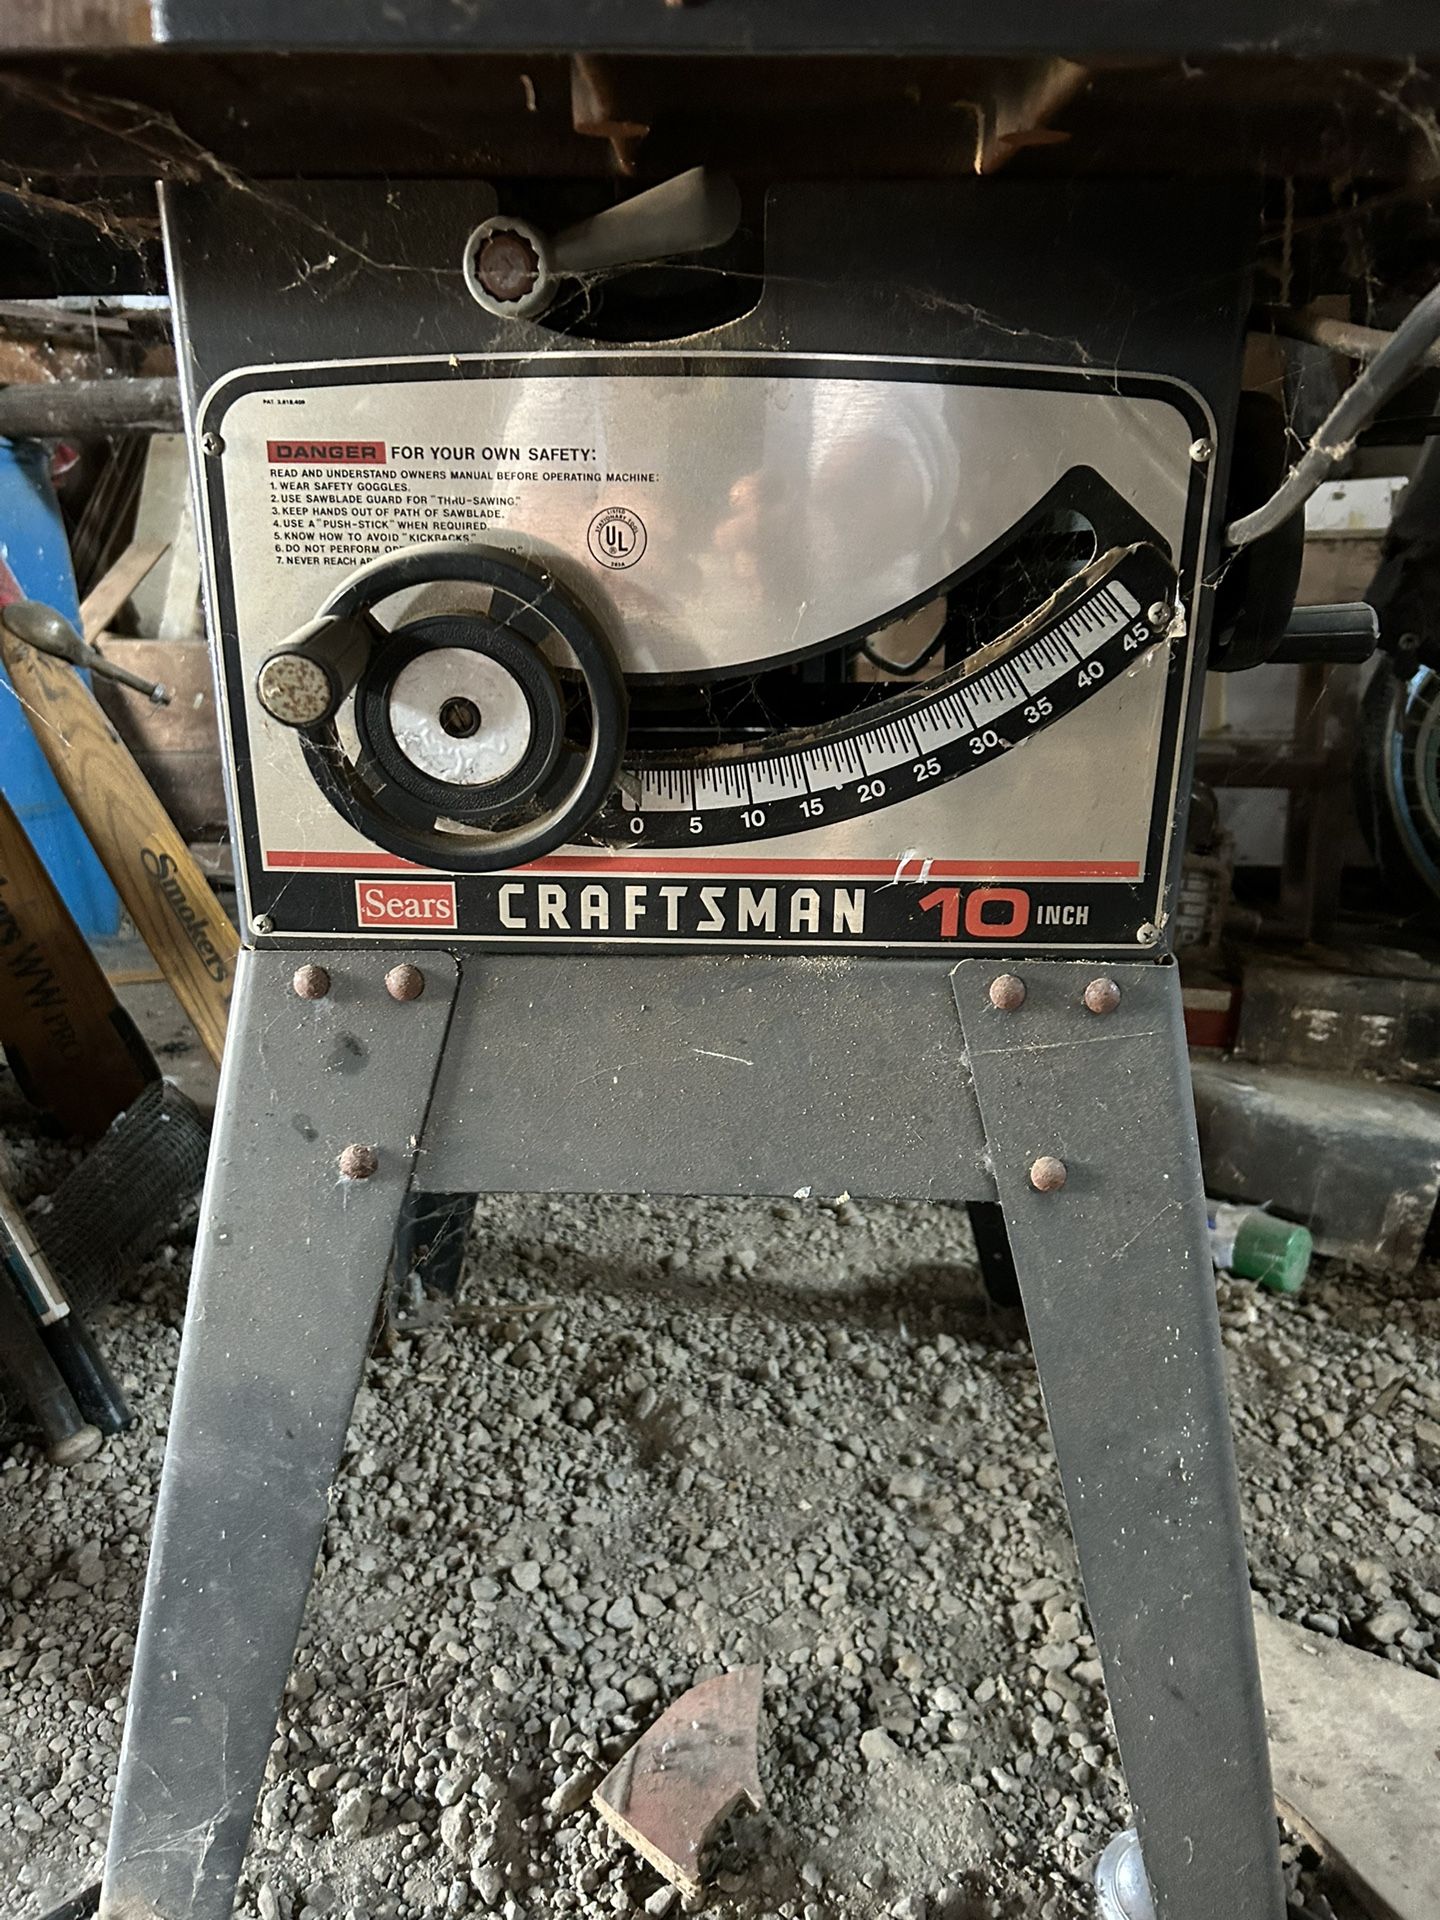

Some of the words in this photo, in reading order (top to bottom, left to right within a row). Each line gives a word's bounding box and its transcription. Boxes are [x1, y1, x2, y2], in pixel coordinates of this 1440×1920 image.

[276, 445, 377, 460] DANGER
[391, 446, 425, 460] FOR
[430, 446, 476, 461] YOUR
[481, 447, 521, 461] OWN
[528, 447, 597, 462] SAFETY:
[270, 468, 298, 478] READ
[301, 469, 324, 478] AND
[326, 469, 398, 479] UNDERSTAND
[400, 470, 447, 480] OWNERS
[450, 470, 494, 480] MANUAL
[496, 471, 539, 481] BEFORE
[542, 472, 602, 482] OPERATING
[606, 473, 660, 483] MACHINE:
[270, 481, 278, 491] 1.
[279, 481, 310, 491] WEAR
[314, 481, 353, 491] SAFETY
[357, 482, 411, 492] GOGGLES.
[270, 494, 279, 504] 2.
[281, 494, 301, 504] USE
[306, 494, 363, 504] SAWBLADE
[366, 495, 403, 504] GUARD
[406, 495, 428, 504] FOR
[271, 507, 281, 516] 3.
[282, 507, 309, 516] KEEP
[312, 507, 348, 516] HANDS
[351, 508, 372, 517] OUT
[375, 508, 390, 517] OF
[393, 508, 420, 517] PATH
[424, 508, 439, 518] OF
[443, 509, 505, 519] SAWBLADE.
[272, 519, 282, 528] 4.
[283, 519, 304, 528] USE
[308, 520, 315, 528] A
[397, 520, 429, 530] WHEN
[432, 521, 491, 532] REQUIRED.
[273, 531, 283, 541] 5.
[284, 531, 315, 541] KNOW
[319, 532, 344, 541] HOW
[348, 532, 362, 541] TO
[366, 532, 400, 542] AVOID
[606, 525, 629, 552] UL
[274, 544, 284, 553] 6.
[285, 544, 300, 553] DO
[304, 544, 326, 553] NOT
[330, 544, 380, 554] PERFORM
[276, 556, 285, 565] 7.
[286, 556, 320, 565] NEVER
[323, 556, 357, 566] REACH
[1121, 621, 1150, 652] 45
[1076, 660, 1105, 689] 40
[1023, 696, 1054, 724] 35
[968, 729, 999, 755] 30
[912, 757, 942, 782] 25
[857, 779, 887, 803] 20
[740, 808, 767, 828] 10
[799, 800, 825, 818] 15
[629, 816, 645, 834] 0
[689, 816, 704, 834] 5
[364, 888, 452, 920] Sears
[498, 882, 866, 934] CRAFTSMAN
[918, 886, 1031, 938] 10
[1036, 905, 1090, 926] INCH
[140, 848, 228, 983] Smokers
